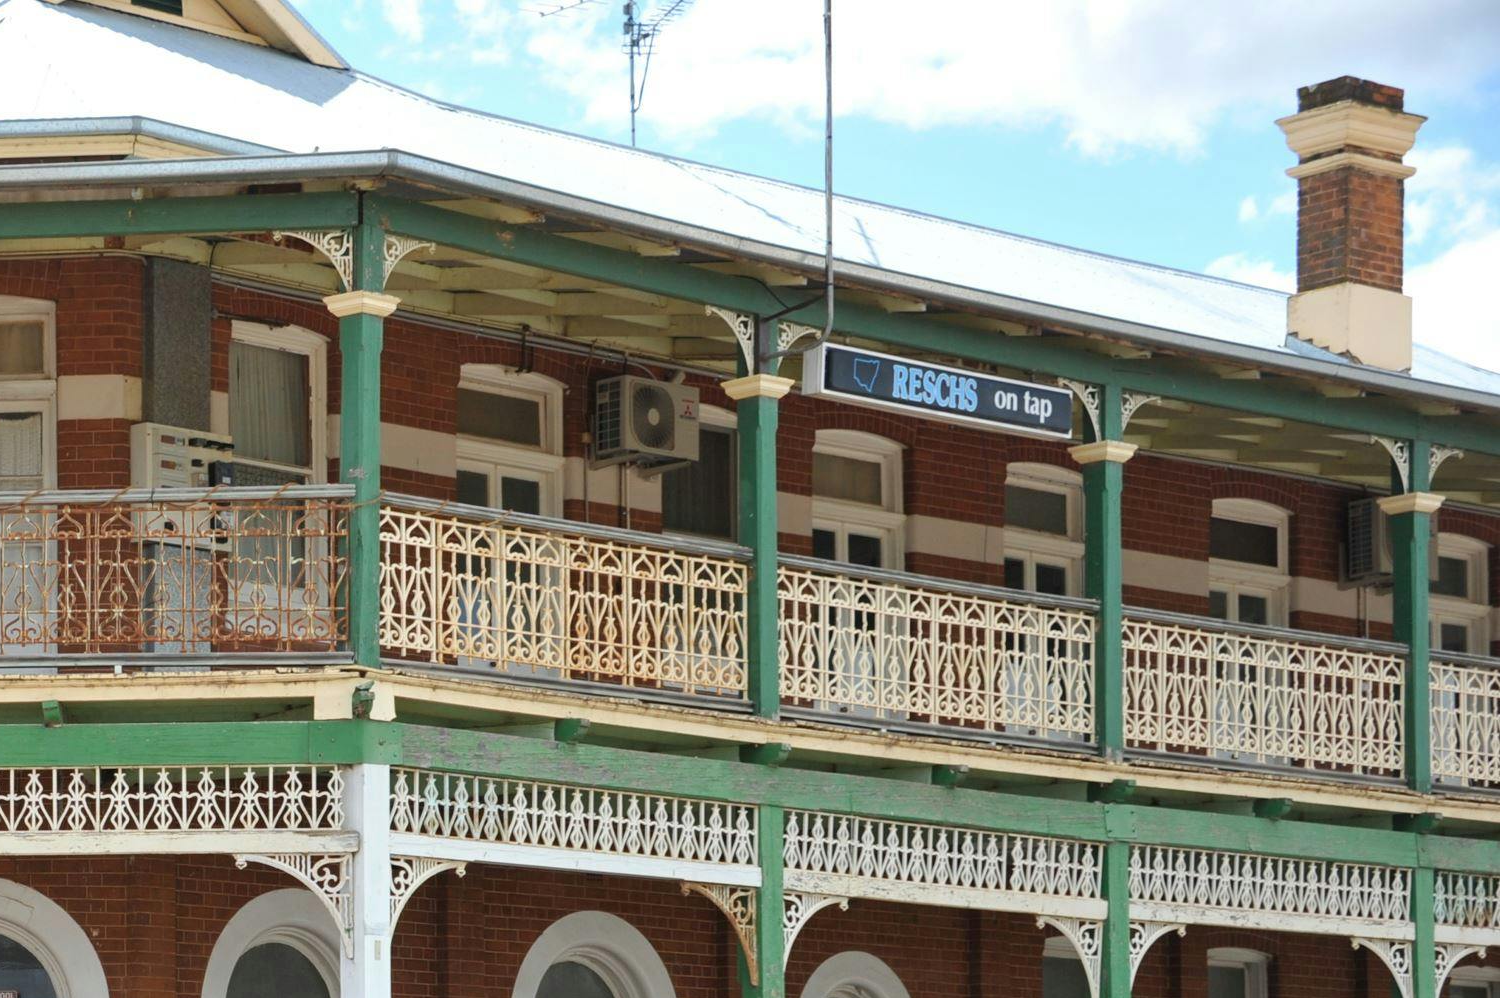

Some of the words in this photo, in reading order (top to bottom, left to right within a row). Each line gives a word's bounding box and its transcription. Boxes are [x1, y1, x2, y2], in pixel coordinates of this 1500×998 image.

[892, 364, 978, 412] RESCHS
[994, 390, 1018, 411] on
[1024, 390, 1052, 424] tap
